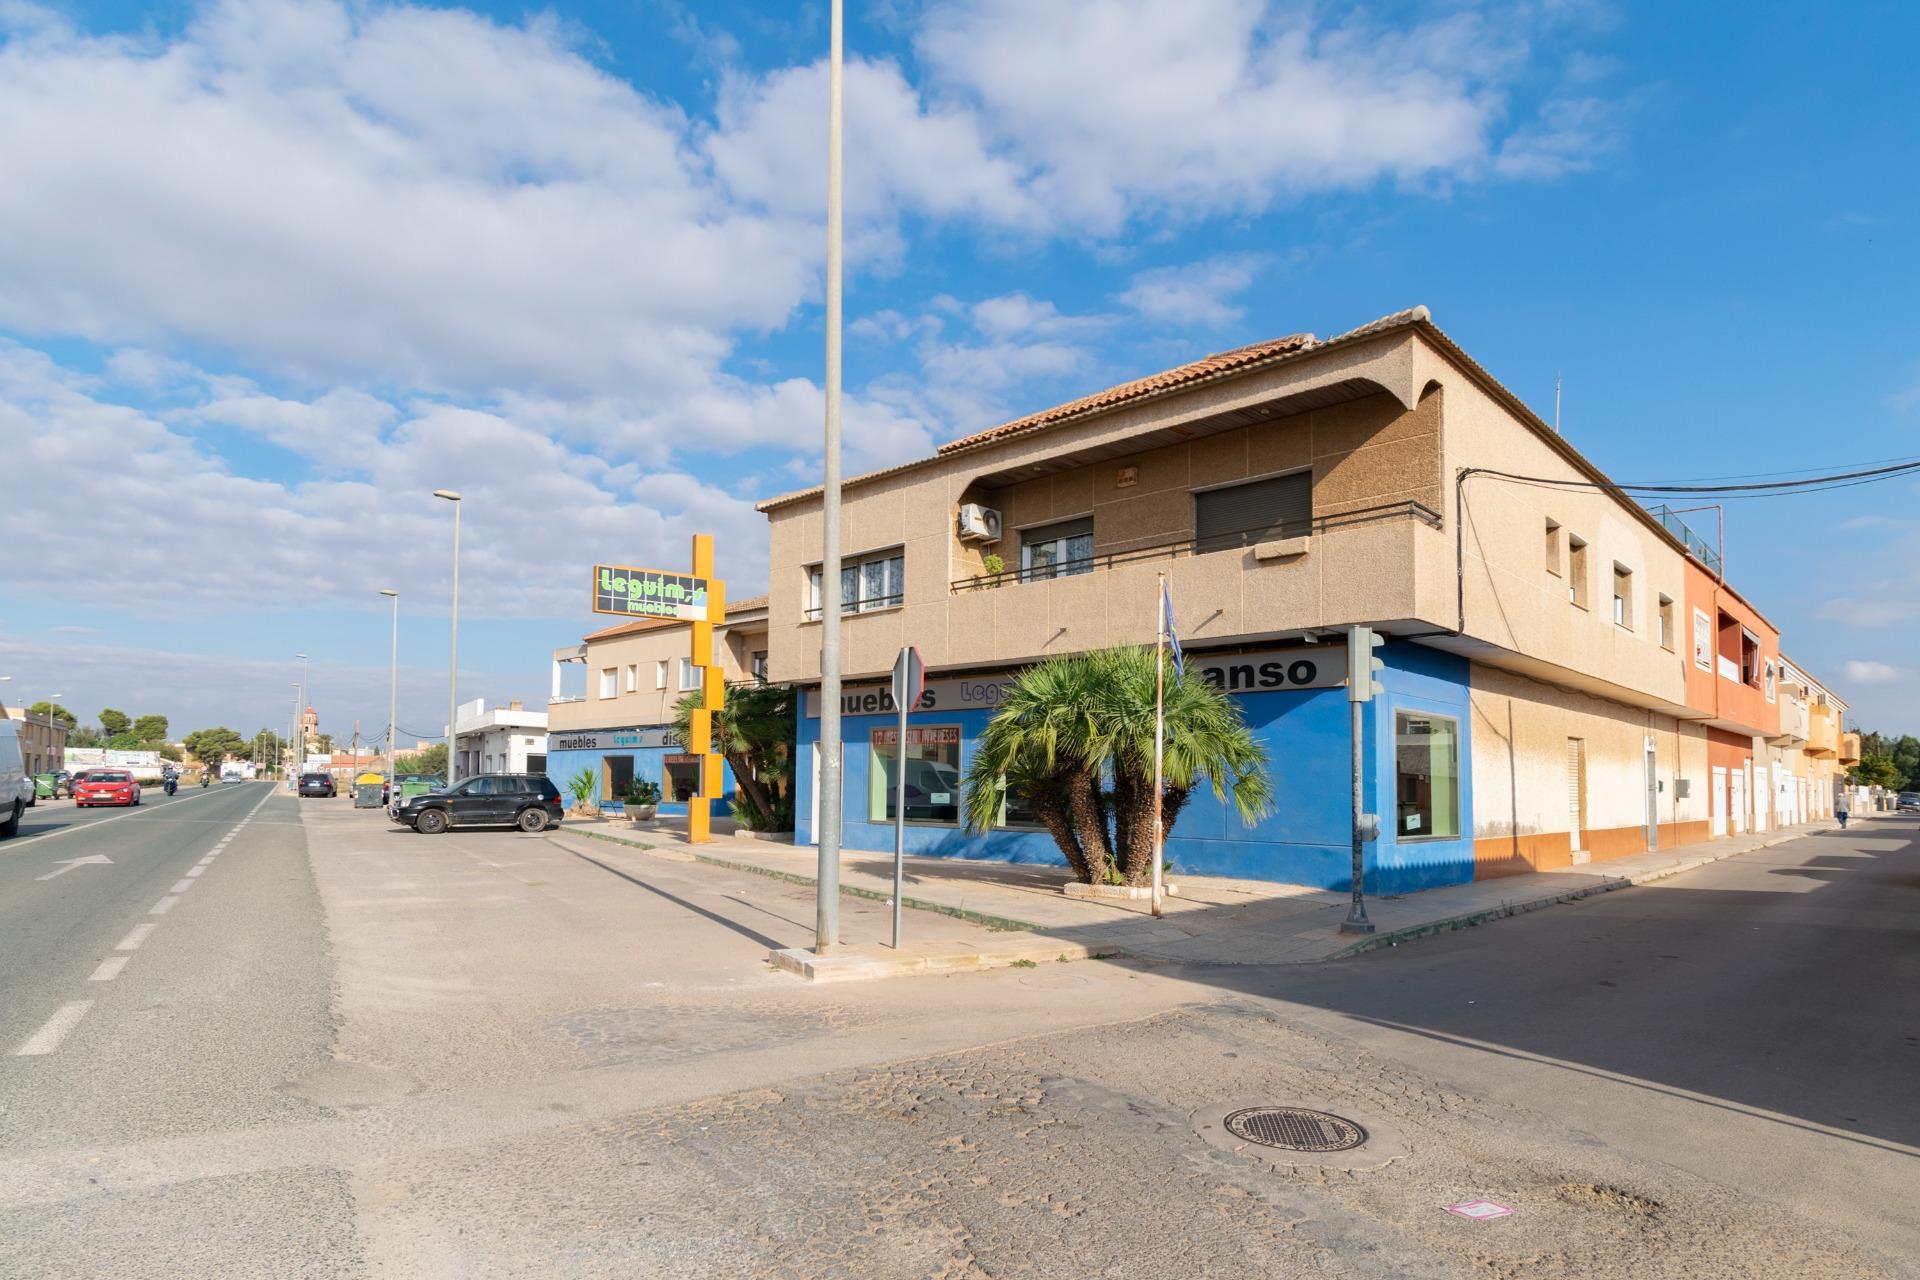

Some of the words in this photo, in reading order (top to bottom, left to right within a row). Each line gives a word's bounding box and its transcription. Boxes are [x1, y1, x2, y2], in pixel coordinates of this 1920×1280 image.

[627, 601, 680, 615] muebles
[559, 736, 597, 748] muebles
[922, 729, 957, 743] INTERESES
